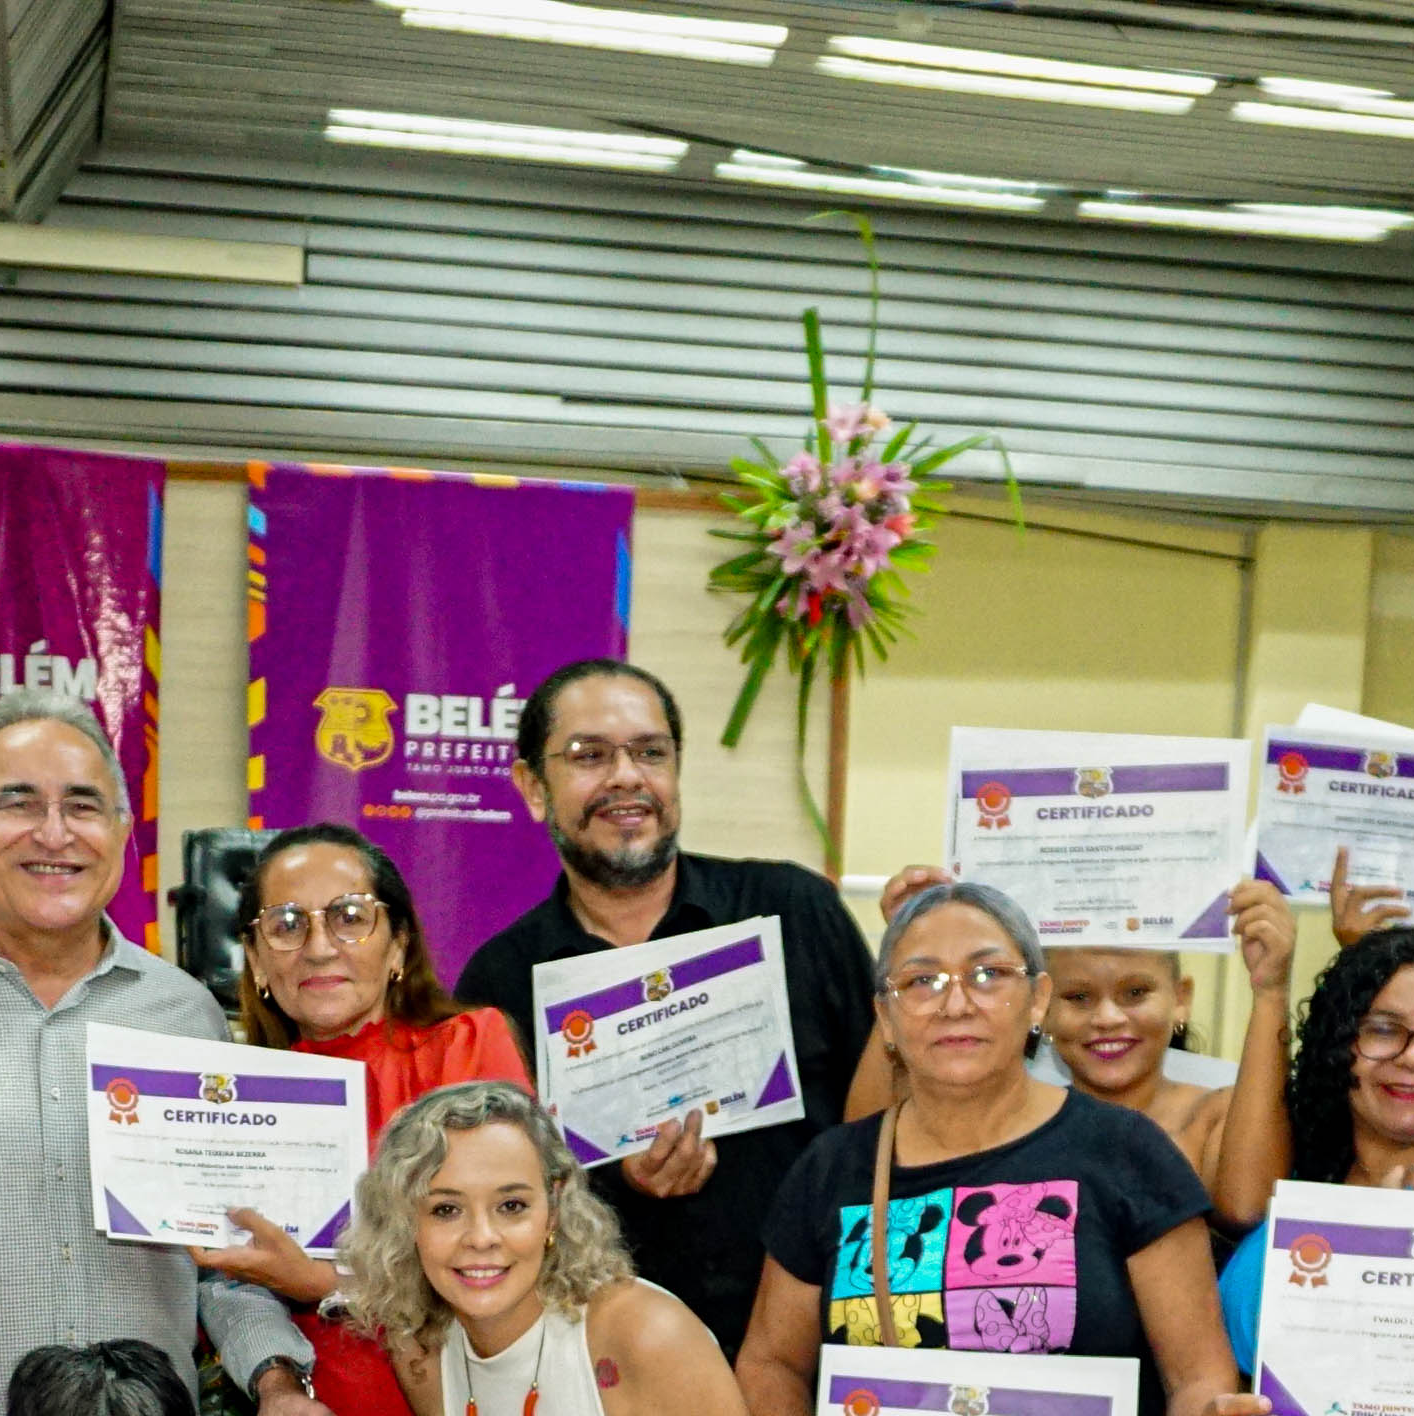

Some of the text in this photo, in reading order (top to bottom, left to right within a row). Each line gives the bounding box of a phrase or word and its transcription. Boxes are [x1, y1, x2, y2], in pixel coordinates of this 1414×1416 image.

[405, 683, 527, 740] BELÉ
[404, 740, 511, 761] PREFEIT
[492, 767, 511, 777] PO
[1036, 804, 1154, 820] CERTIFICADO
[617, 992, 709, 1035] CERTIFICADO
[163, 1109, 277, 1127] CERTIFICADO
